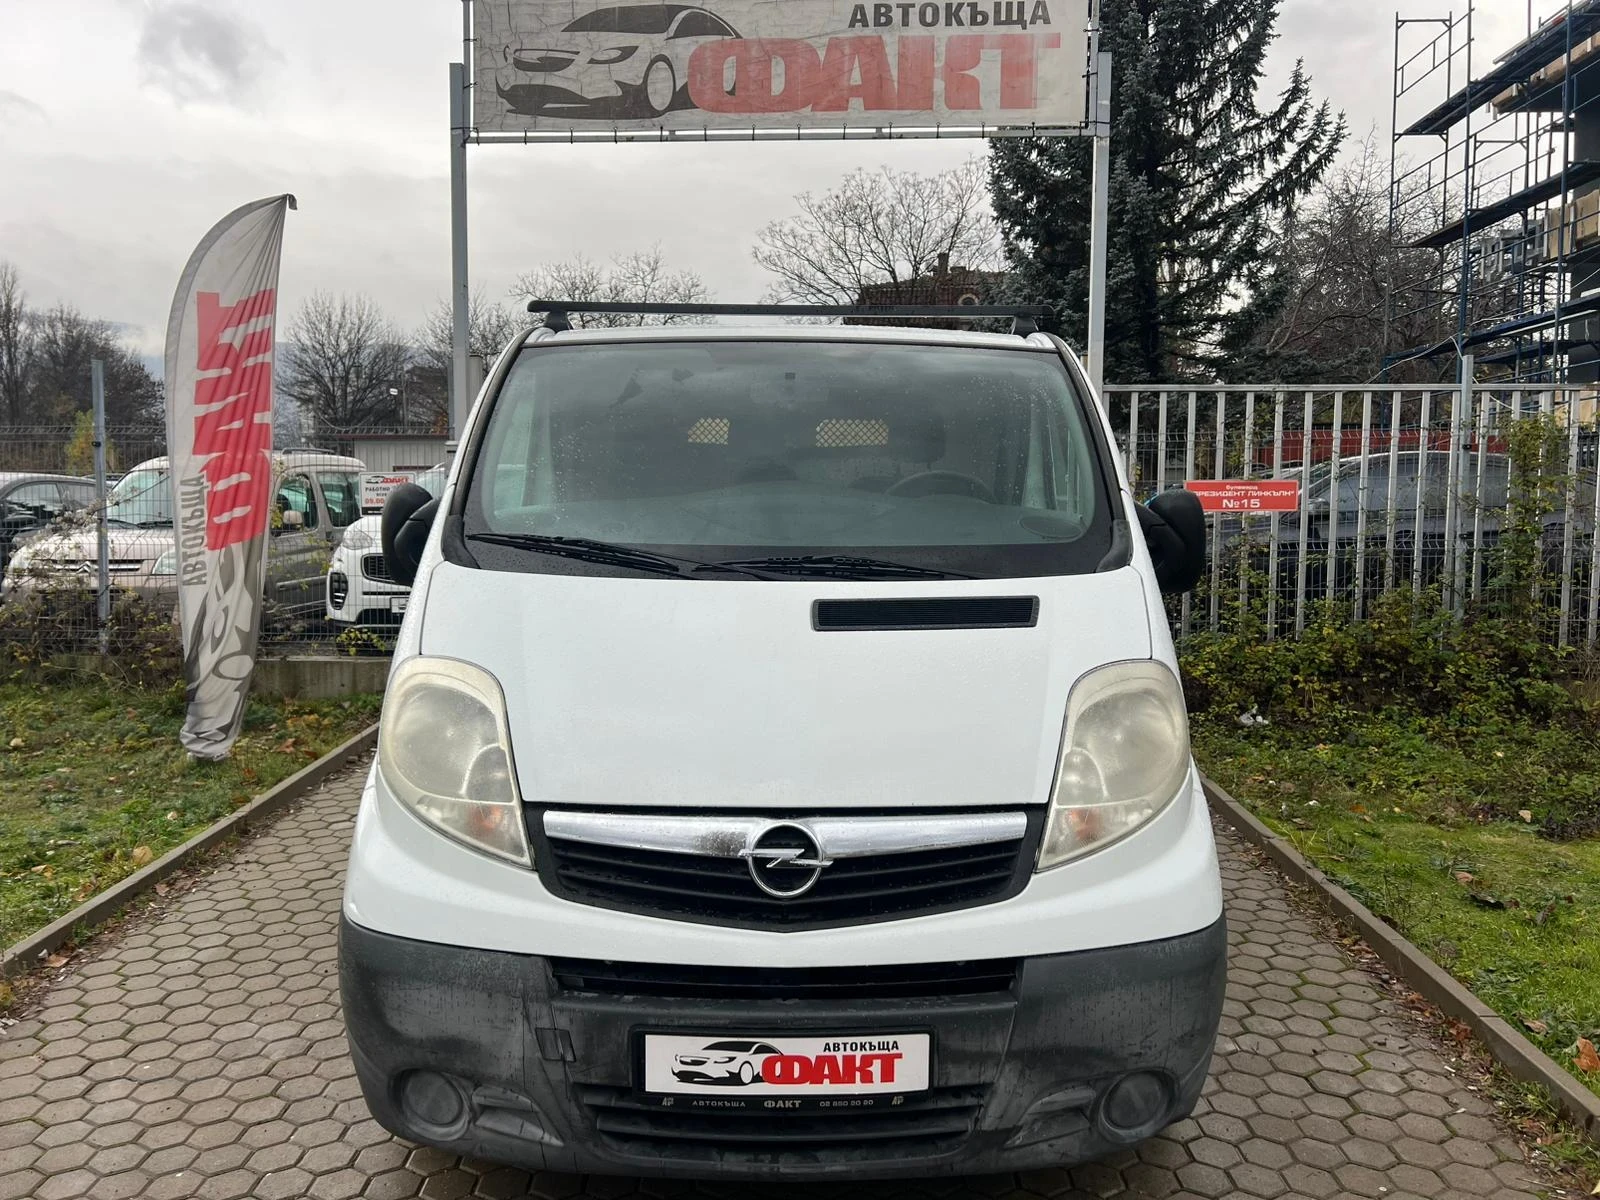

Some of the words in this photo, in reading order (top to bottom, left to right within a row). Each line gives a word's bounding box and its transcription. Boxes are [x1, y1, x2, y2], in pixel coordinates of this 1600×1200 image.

[849, 0, 1051, 30] АВТОКЪЩА
[687, 33, 1061, 113] ФАКТ
[193, 288, 274, 550] ФАКТ
[181, 475, 209, 586] АВТОКЪЩА
[823, 1041, 900, 1053] АВТОКЪЩА
[762, 1053, 903, 1085] ФАКТ
[763, 1100, 802, 1108] ФАКТ
